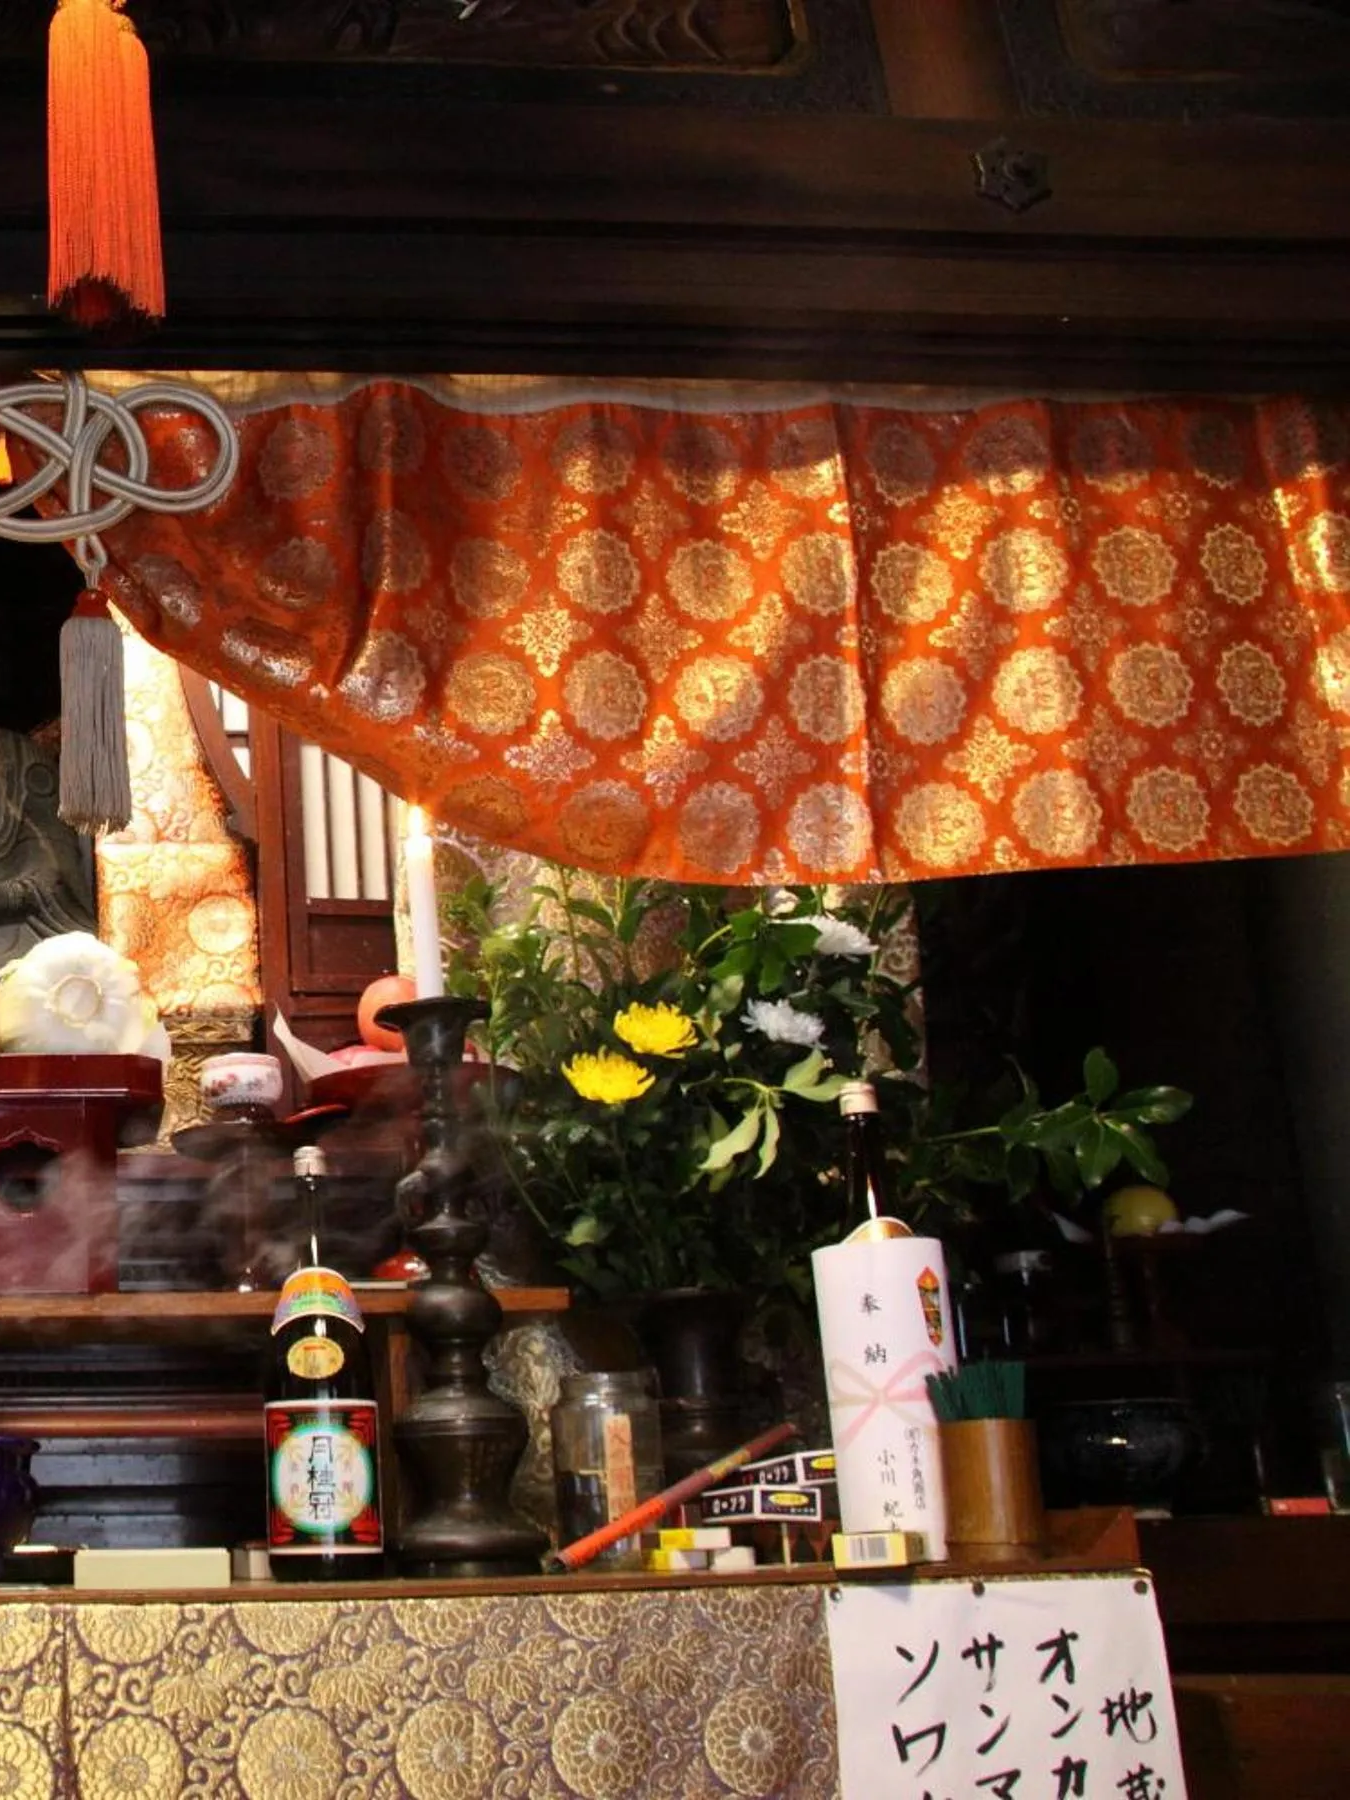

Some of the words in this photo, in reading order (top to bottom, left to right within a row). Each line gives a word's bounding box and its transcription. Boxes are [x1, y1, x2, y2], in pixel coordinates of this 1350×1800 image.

[859, 1293, 887, 1365] 奉納
[307, 1435, 335, 1520] 月桂冠
[891, 1640, 952, 1800] ソワ
[1035, 1628, 1089, 1798] オンカ
